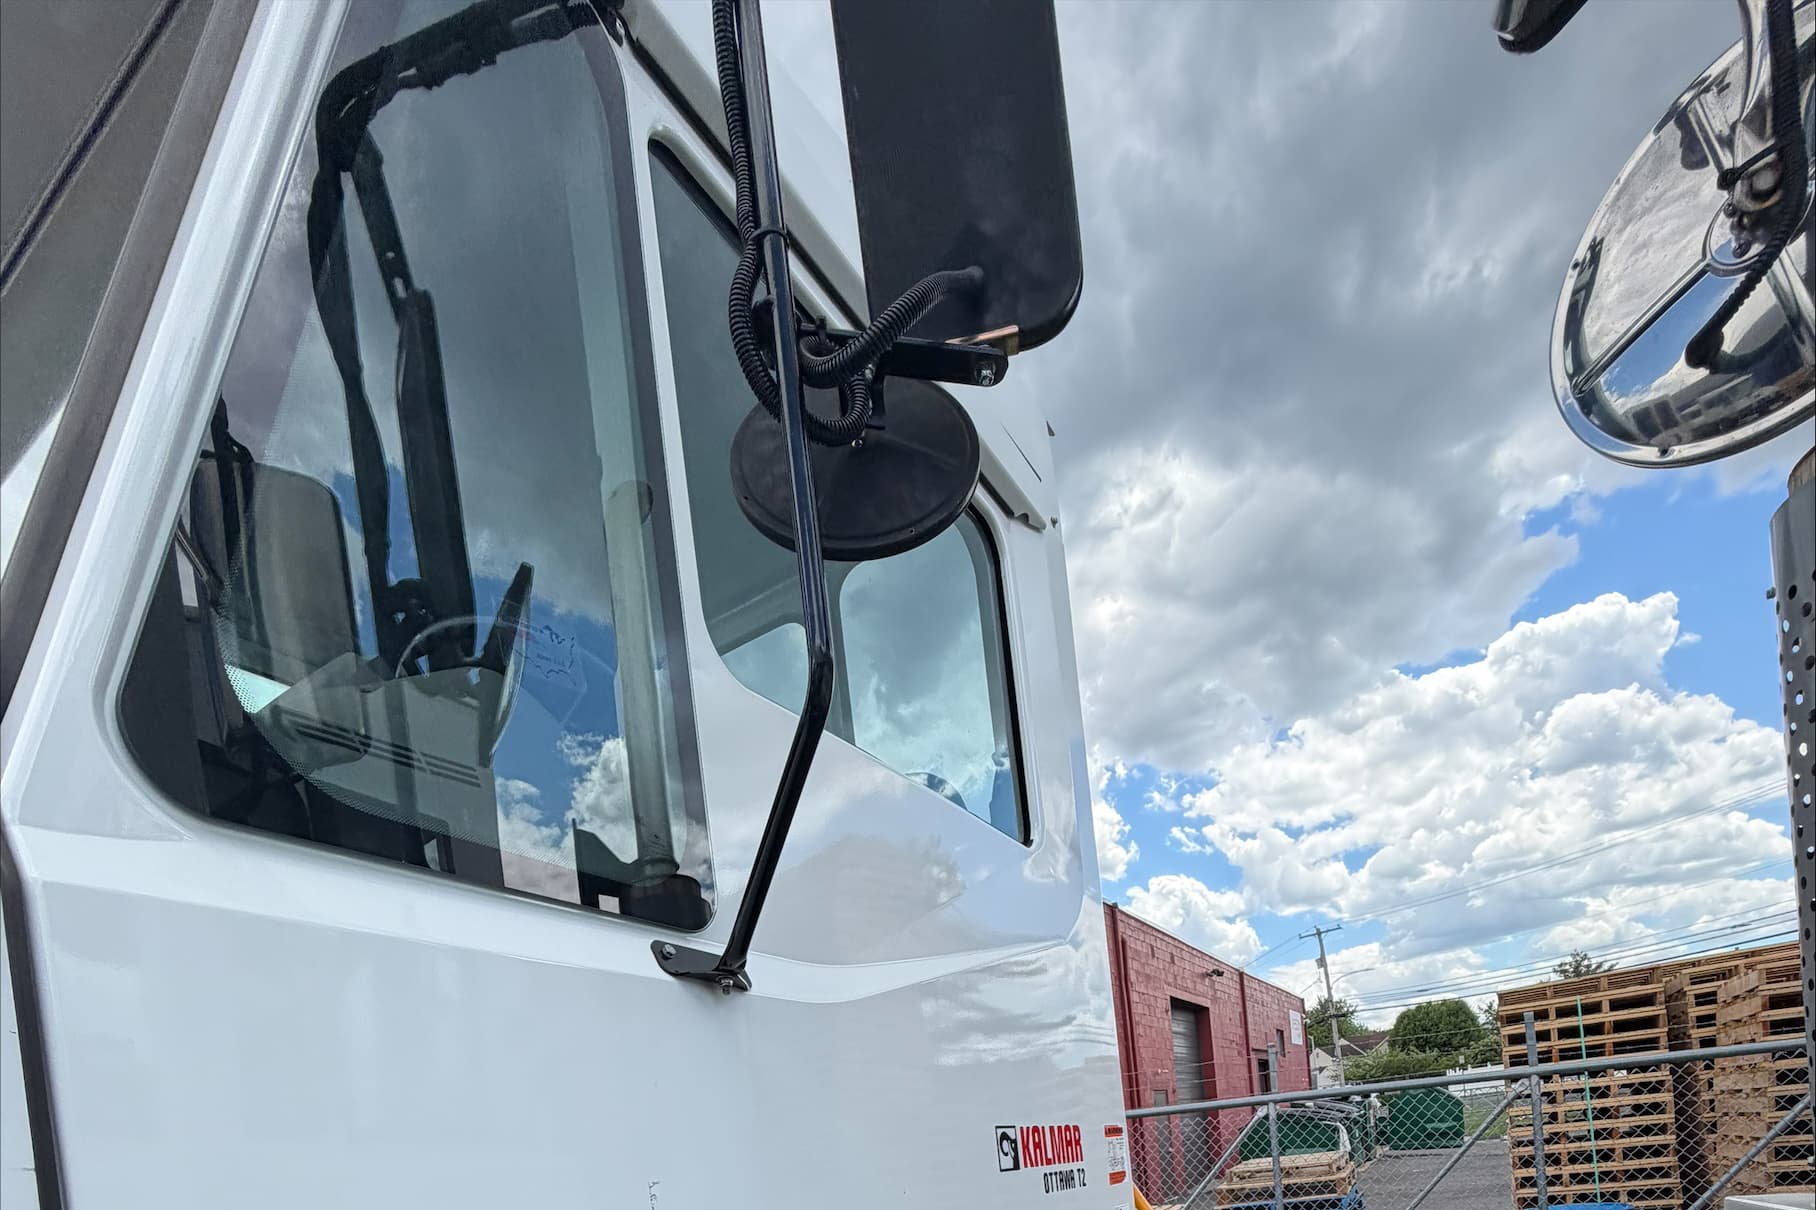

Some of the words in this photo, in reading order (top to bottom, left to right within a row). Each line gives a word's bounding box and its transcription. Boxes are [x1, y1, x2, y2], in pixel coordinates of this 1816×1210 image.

[1020, 1124, 1084, 1168] KALMAR
[1043, 1169, 1076, 1194] OTTAWA
[1077, 1168, 1087, 1188] T2
